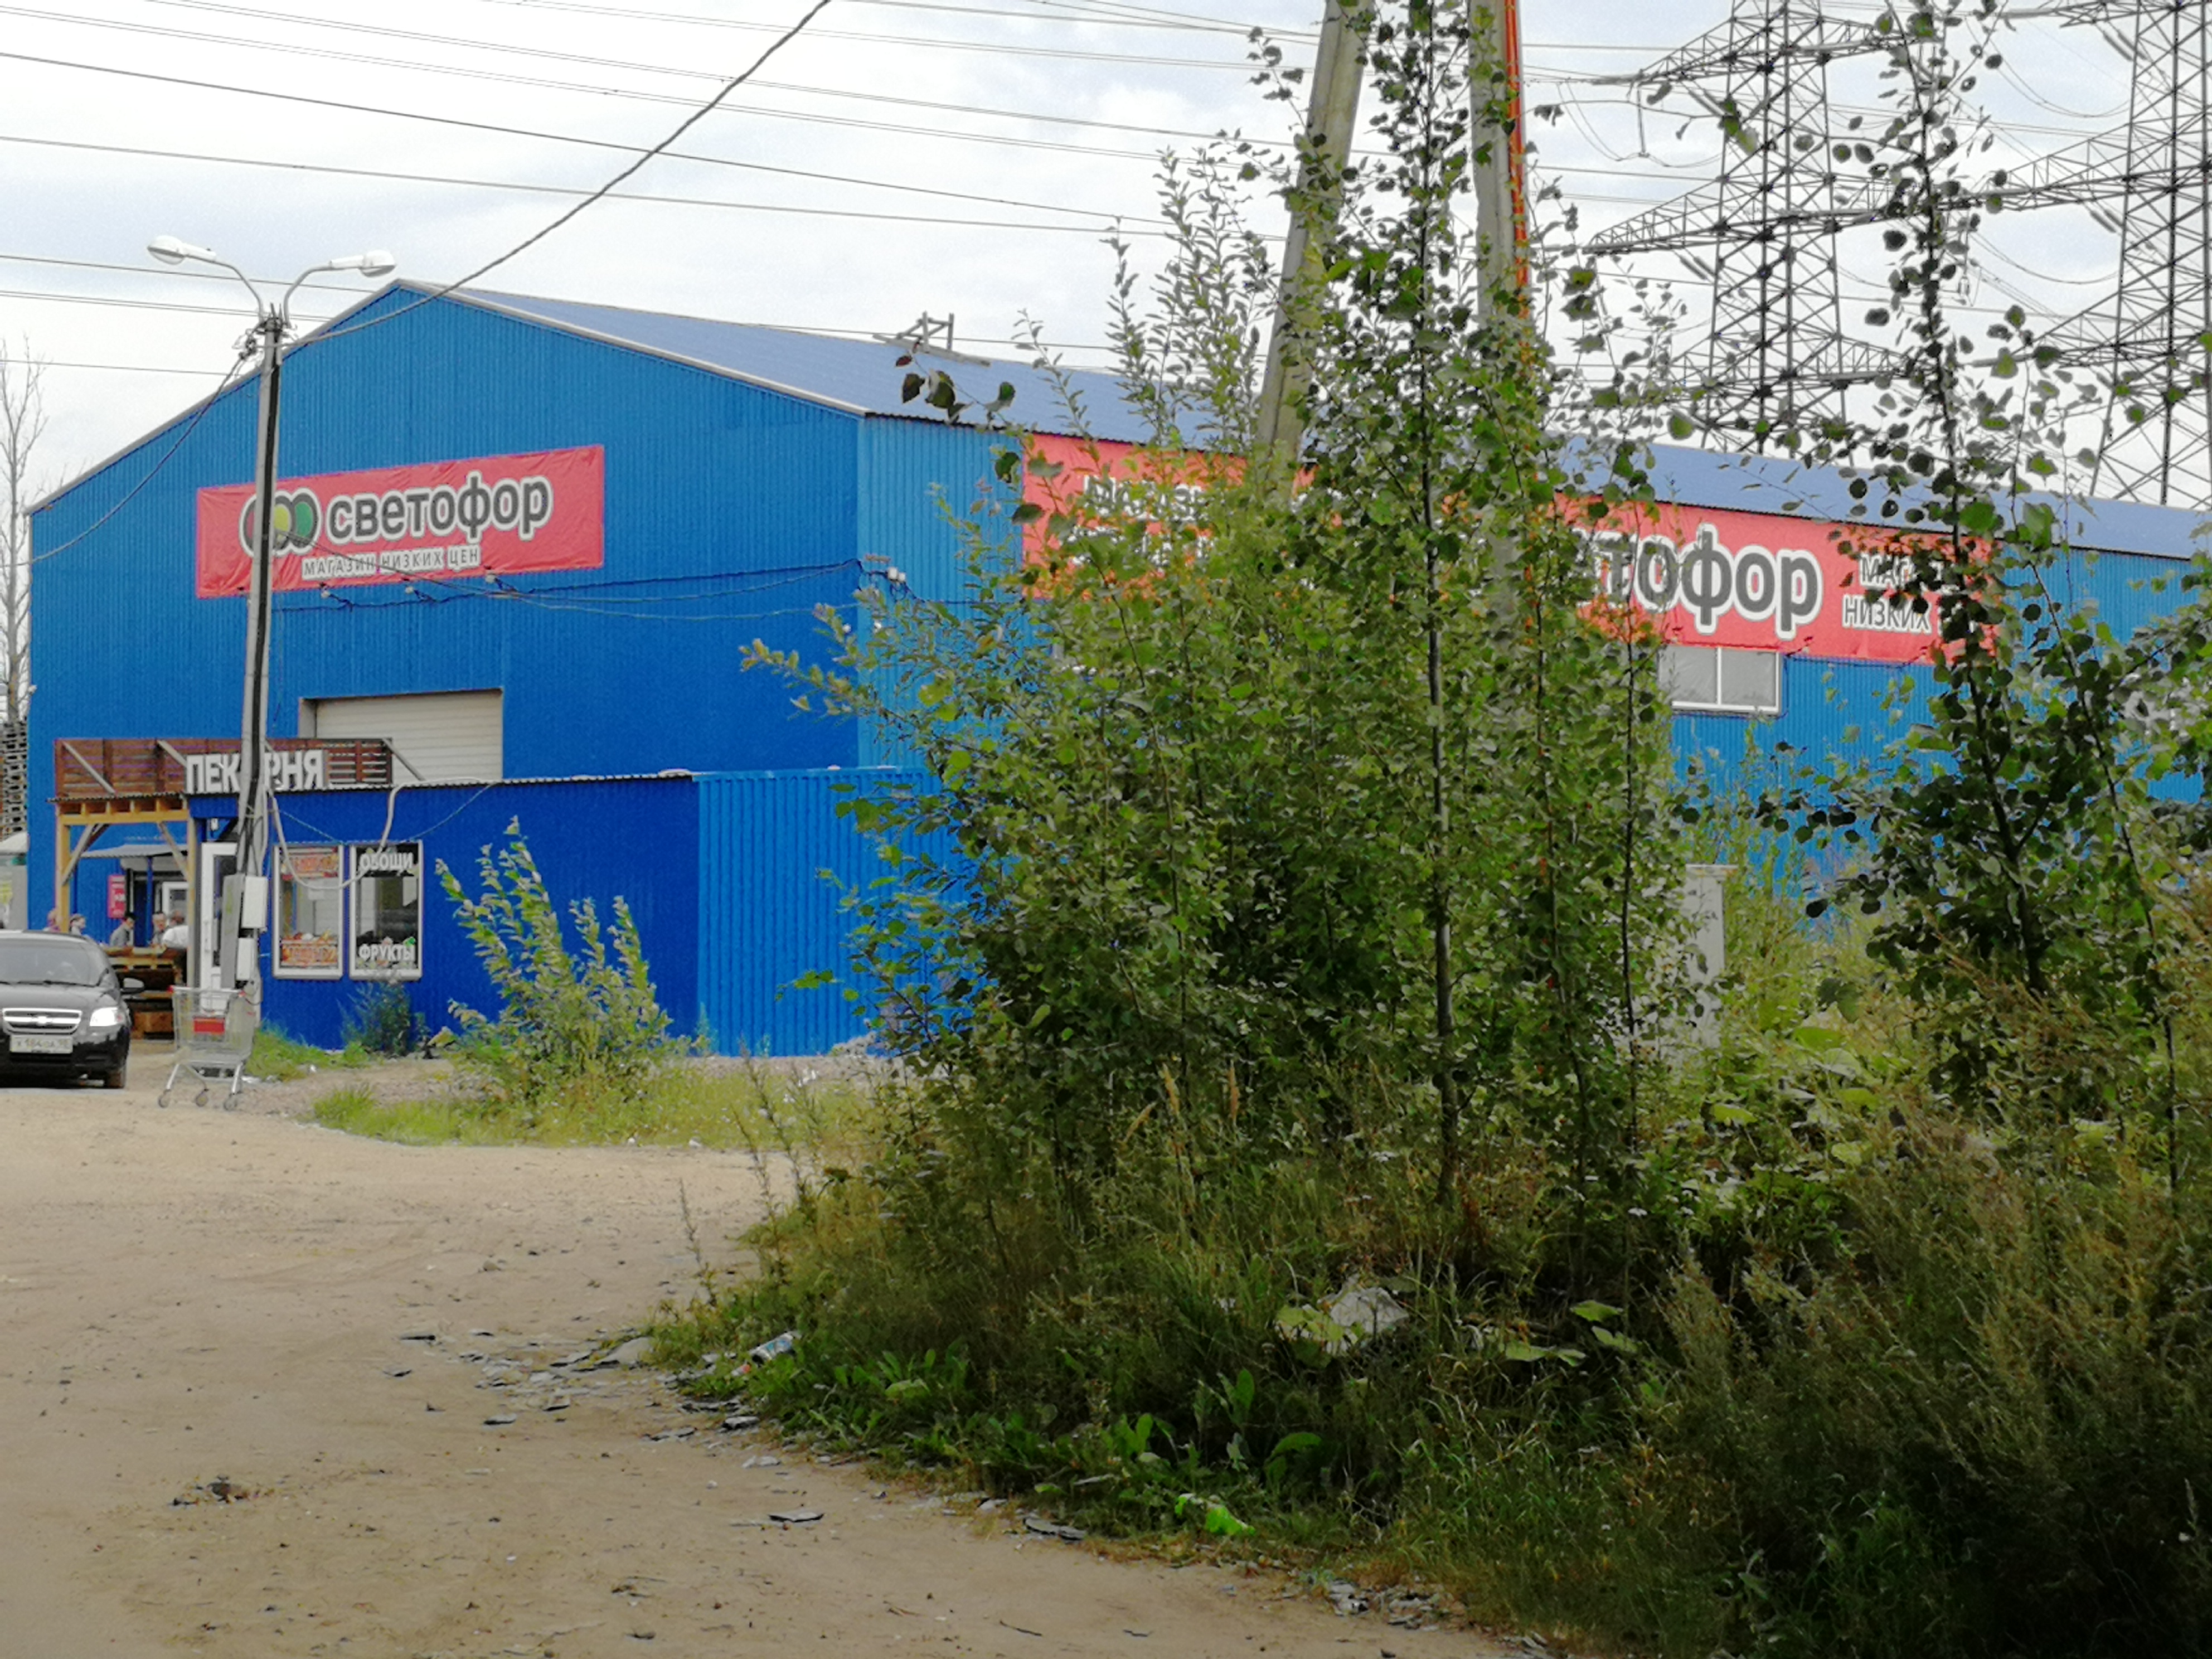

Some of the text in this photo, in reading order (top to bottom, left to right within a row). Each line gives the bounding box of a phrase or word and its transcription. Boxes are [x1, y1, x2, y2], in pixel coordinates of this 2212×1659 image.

[328, 474, 551, 541] светофор
[303, 548, 479, 576] МАГАЗИН НИЗКИХ ЦЕН
[1555, 524, 1821, 638] тофор
[186, 749, 324, 794] ПЕКРНЯ
[358, 943, 416, 963] ФРУКТЫ
